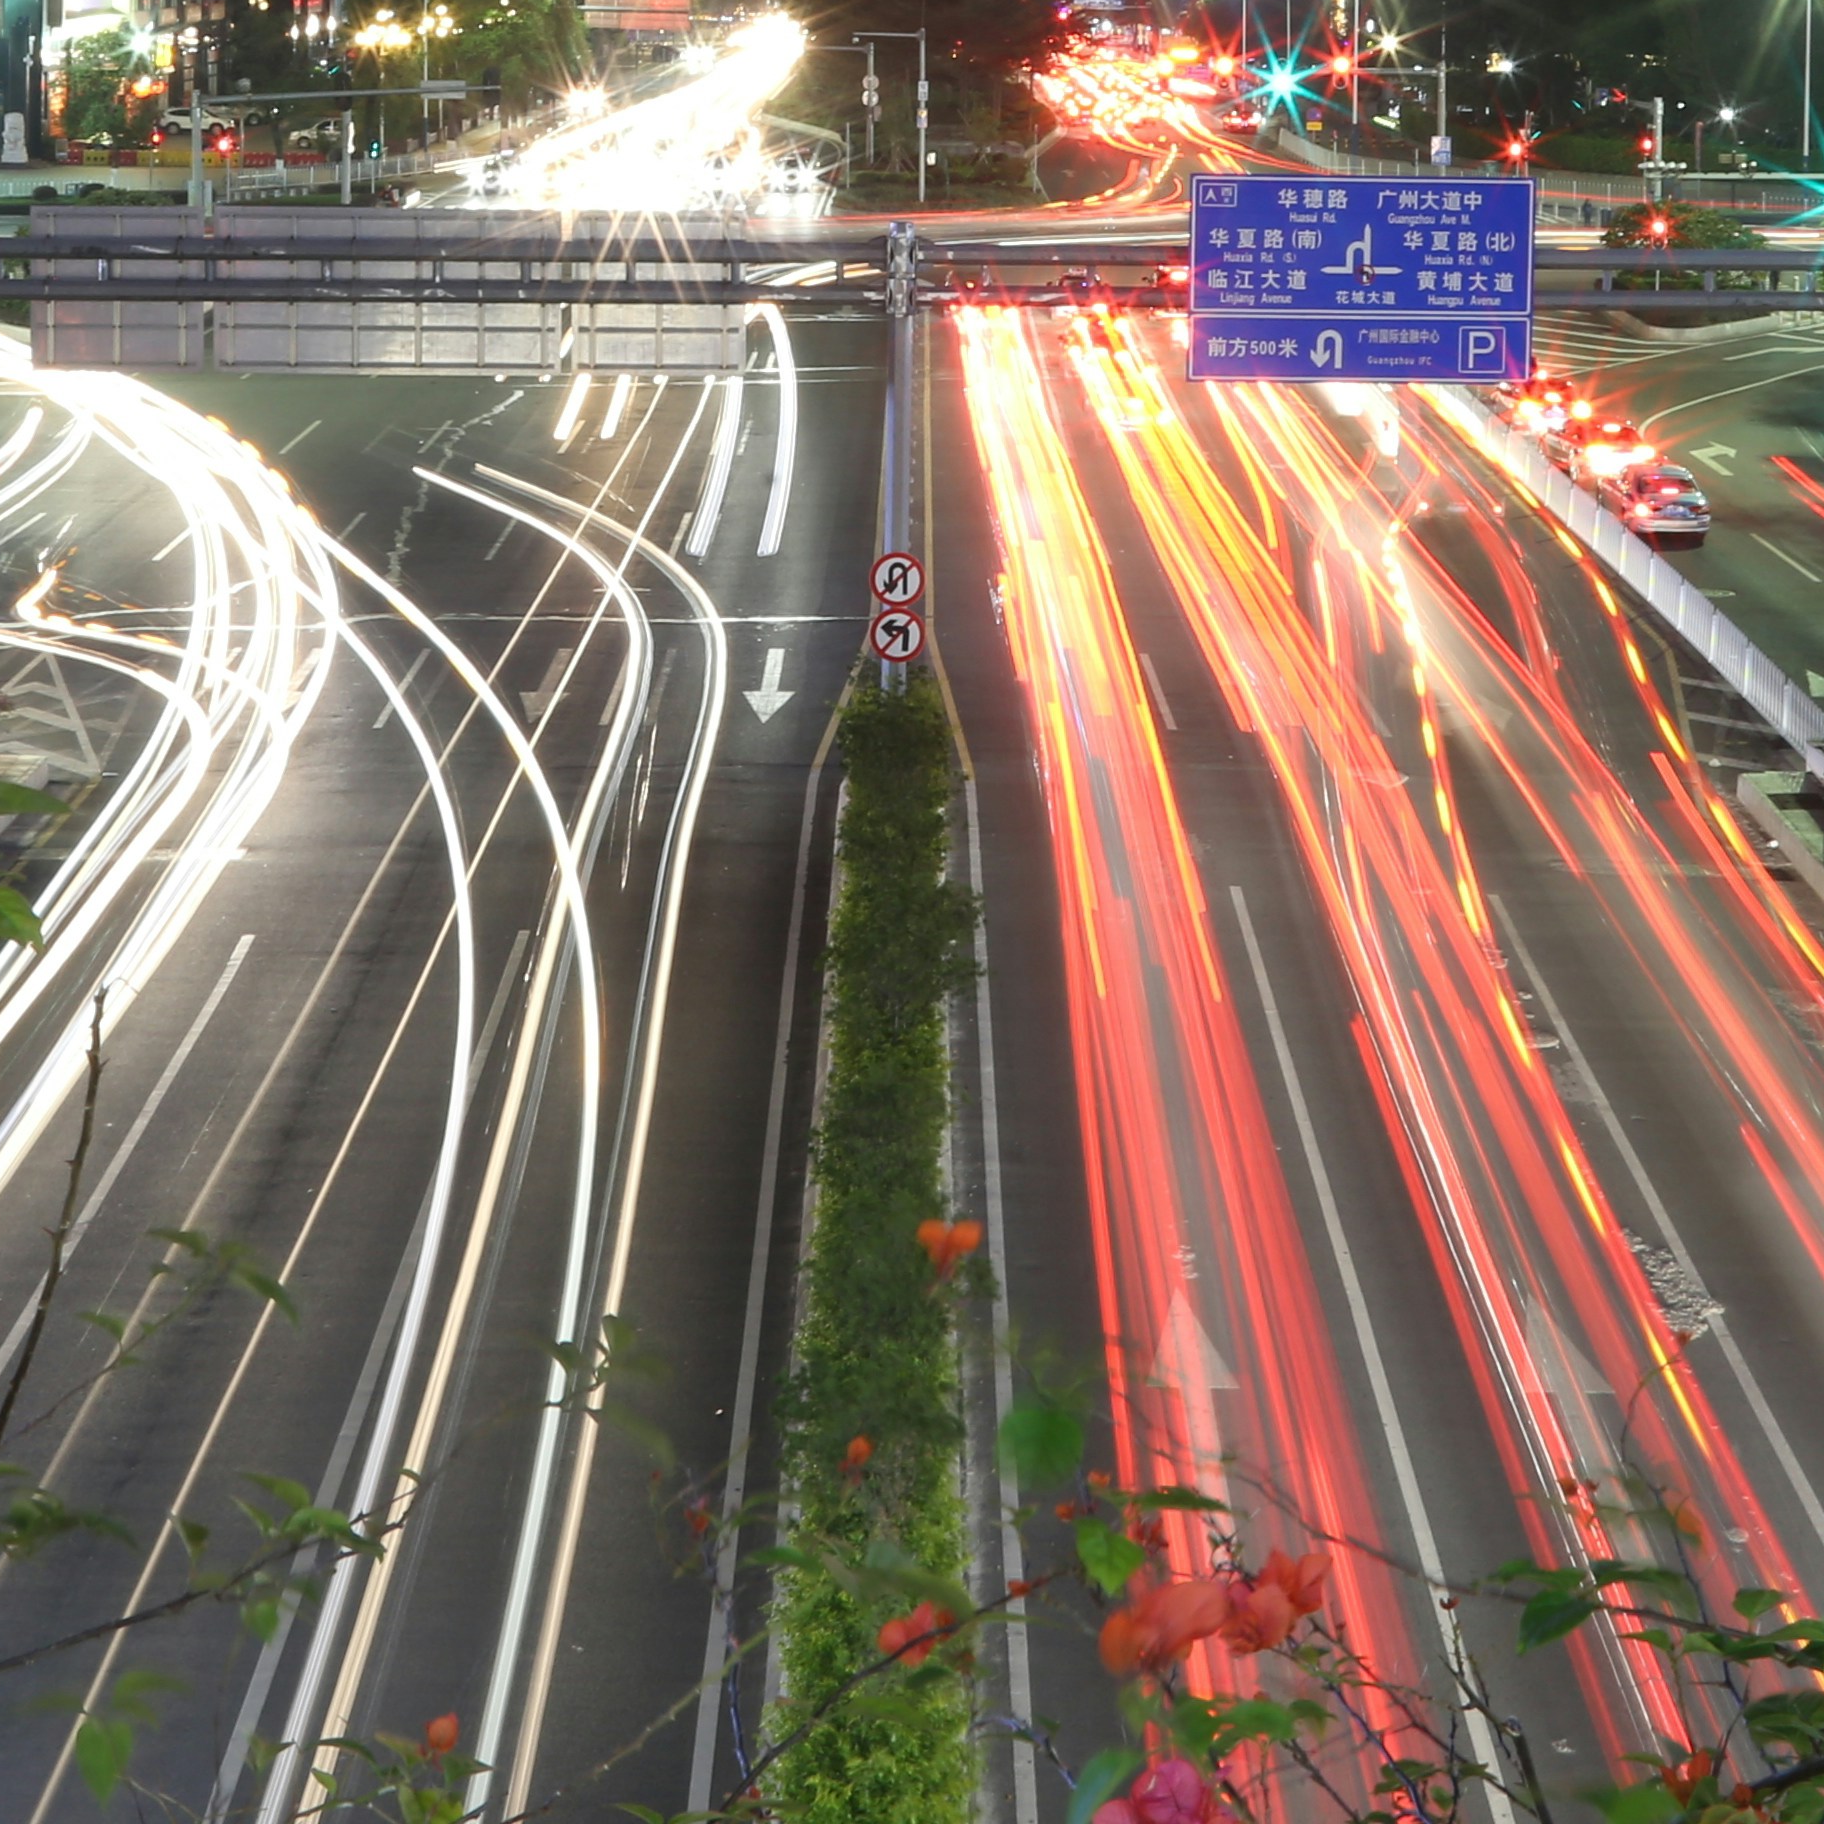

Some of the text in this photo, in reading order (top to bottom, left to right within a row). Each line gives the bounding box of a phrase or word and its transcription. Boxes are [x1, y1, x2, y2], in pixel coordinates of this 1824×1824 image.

[1278, 188, 1348, 209] 华穗路
[1377, 190, 1482, 211] 广州大道中
[1289, 212, 1336, 223] Huasui Rd.
[1388, 213, 1436, 227] Guangzhou
[1440, 214, 1456, 225] Ave
[1223, 251, 1253, 262] Huaxia
[1260, 252, 1274, 262] Rd.
[1424, 254, 1453, 265] Huaxia
[1458, 255, 1474, 265] Rd.
[1208, 269, 1307, 290] 临江大道
[1417, 271, 1513, 292] 黄埔大道
[1220, 292, 1292, 305] Linjiang Avenue
[1336, 291, 1396, 305] 花城大道
[1427, 295, 1501, 308] Huangpu Avenue
[1358, 328, 1440, 344] 广州国际金融中心
[1207, 337, 1298, 358] 前方500米
[1468, 331, 1496, 369] P
[1367, 355, 1432, 366] Guangzhou IFC
